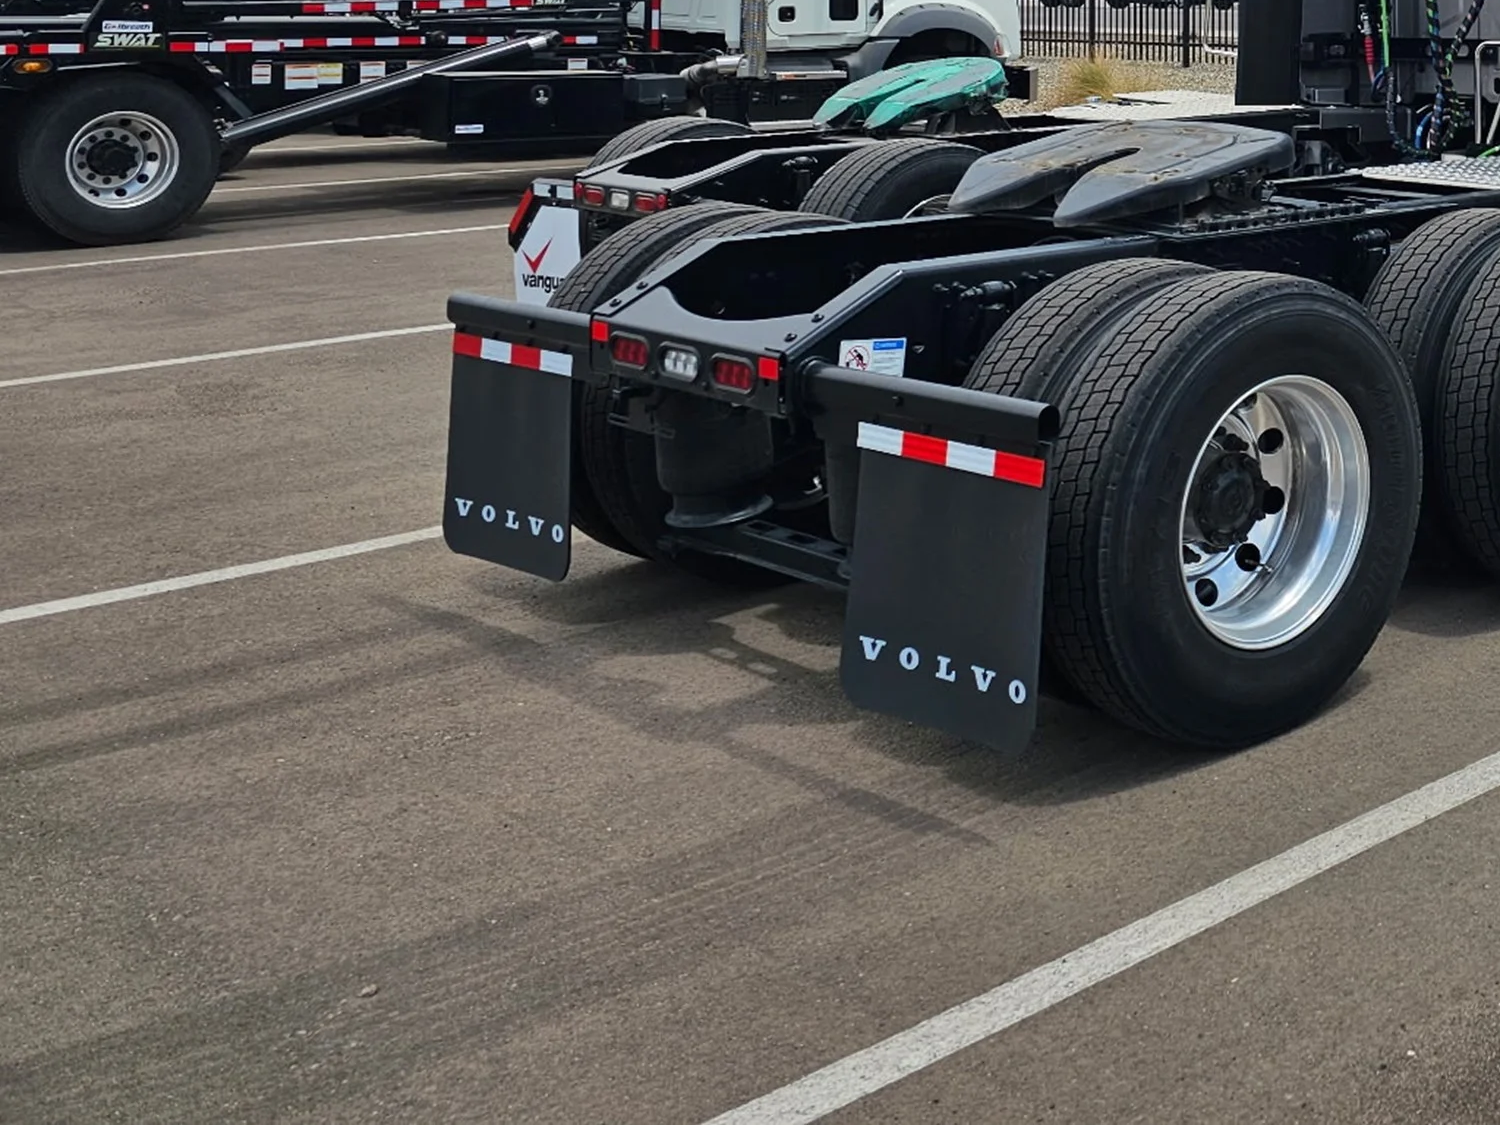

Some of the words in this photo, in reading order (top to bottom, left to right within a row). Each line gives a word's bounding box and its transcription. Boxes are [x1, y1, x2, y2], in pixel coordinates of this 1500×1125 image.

[93, 34, 162, 48] SWAT
[522, 274, 565, 293] vangu
[455, 497, 564, 543] VOLVO
[859, 635, 1026, 704] VOLVO
